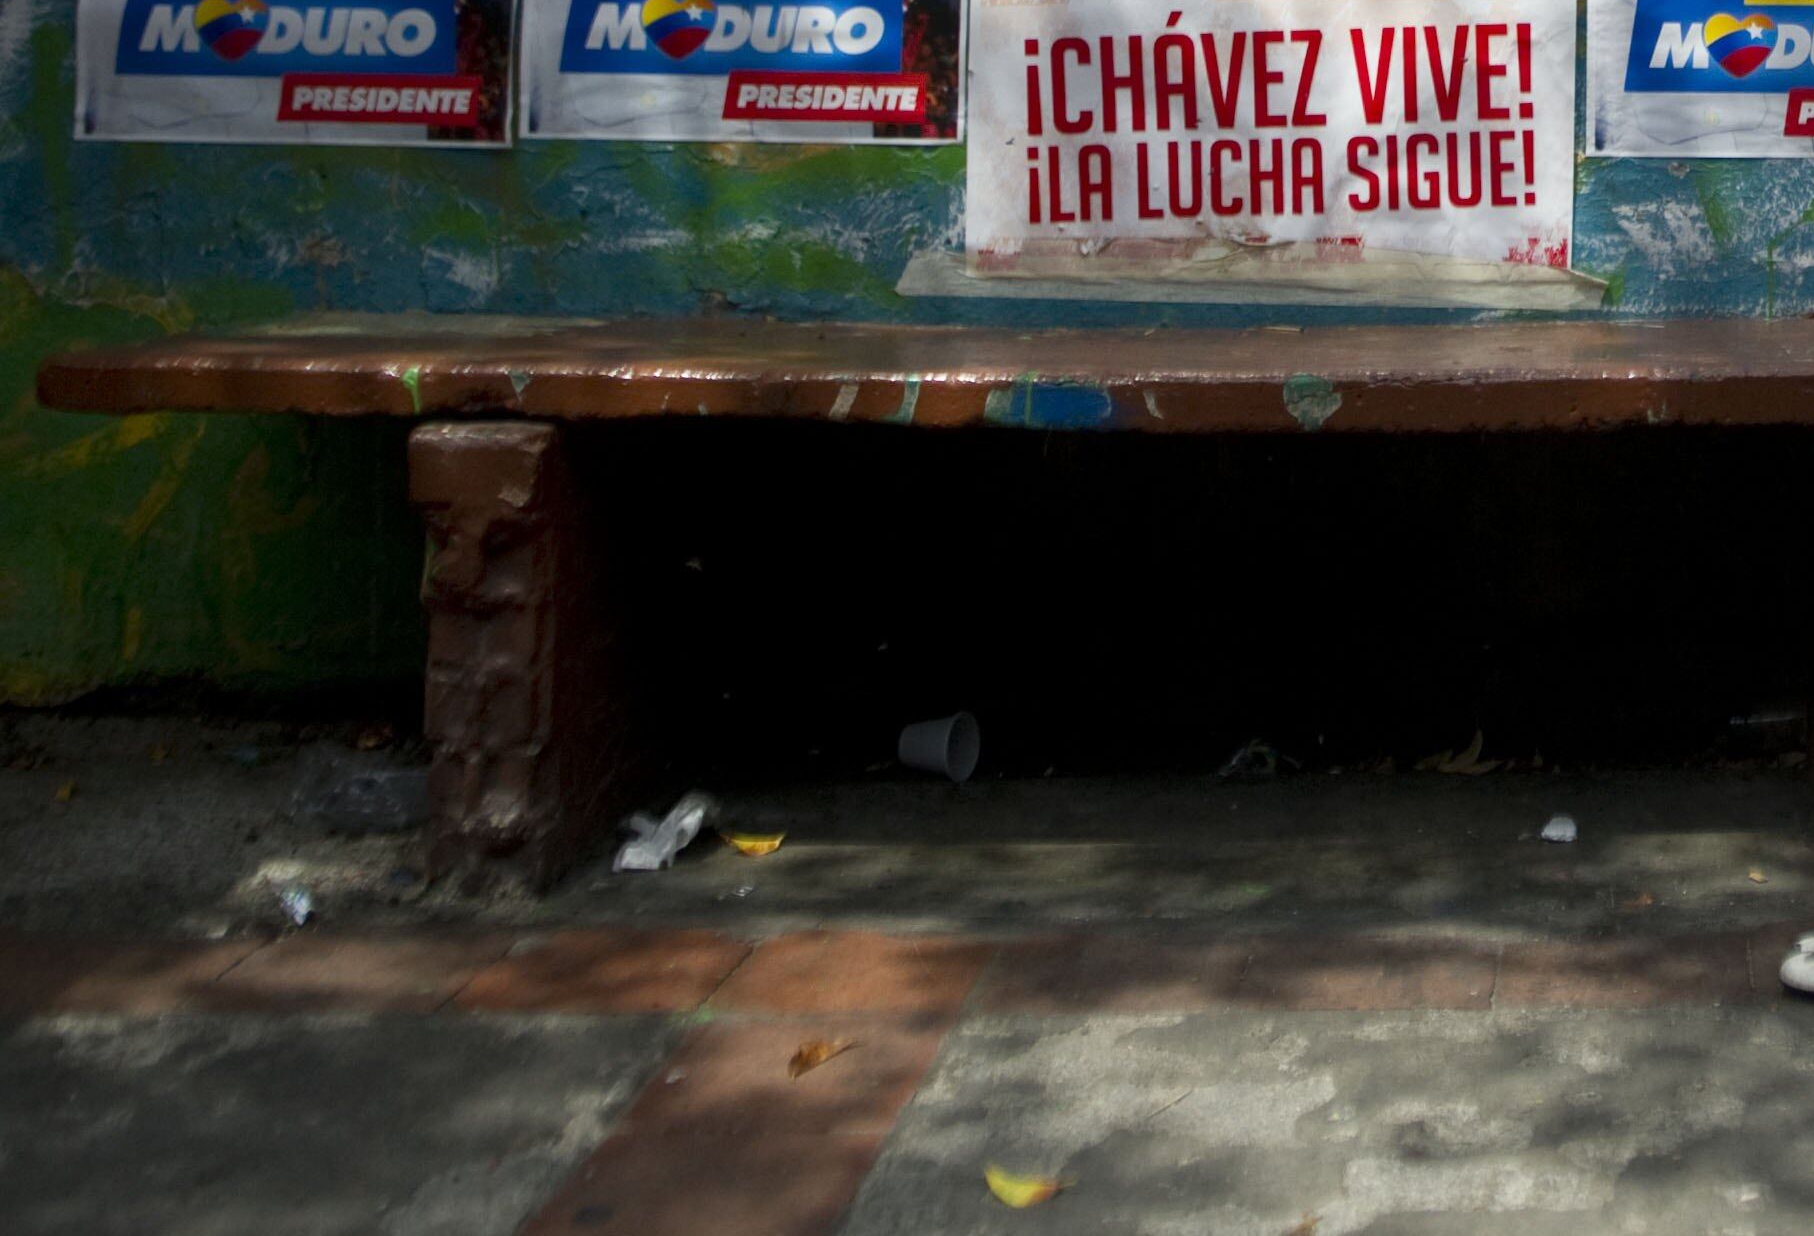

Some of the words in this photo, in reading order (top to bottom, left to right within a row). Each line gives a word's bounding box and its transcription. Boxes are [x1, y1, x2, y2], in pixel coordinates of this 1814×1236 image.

[293, 85, 471, 115] PRESIDENTE
[737, 83, 919, 113] PRESIDENTE
[1024, 11, 1328, 136] ¡CHÁVEZ
[1350, 23, 1534, 125] VIVE!
[1027, 145, 1113, 225] ¡LA
[1137, 137, 1325, 219] LUCHA
[1346, 129, 1536, 212] SIGUE!
